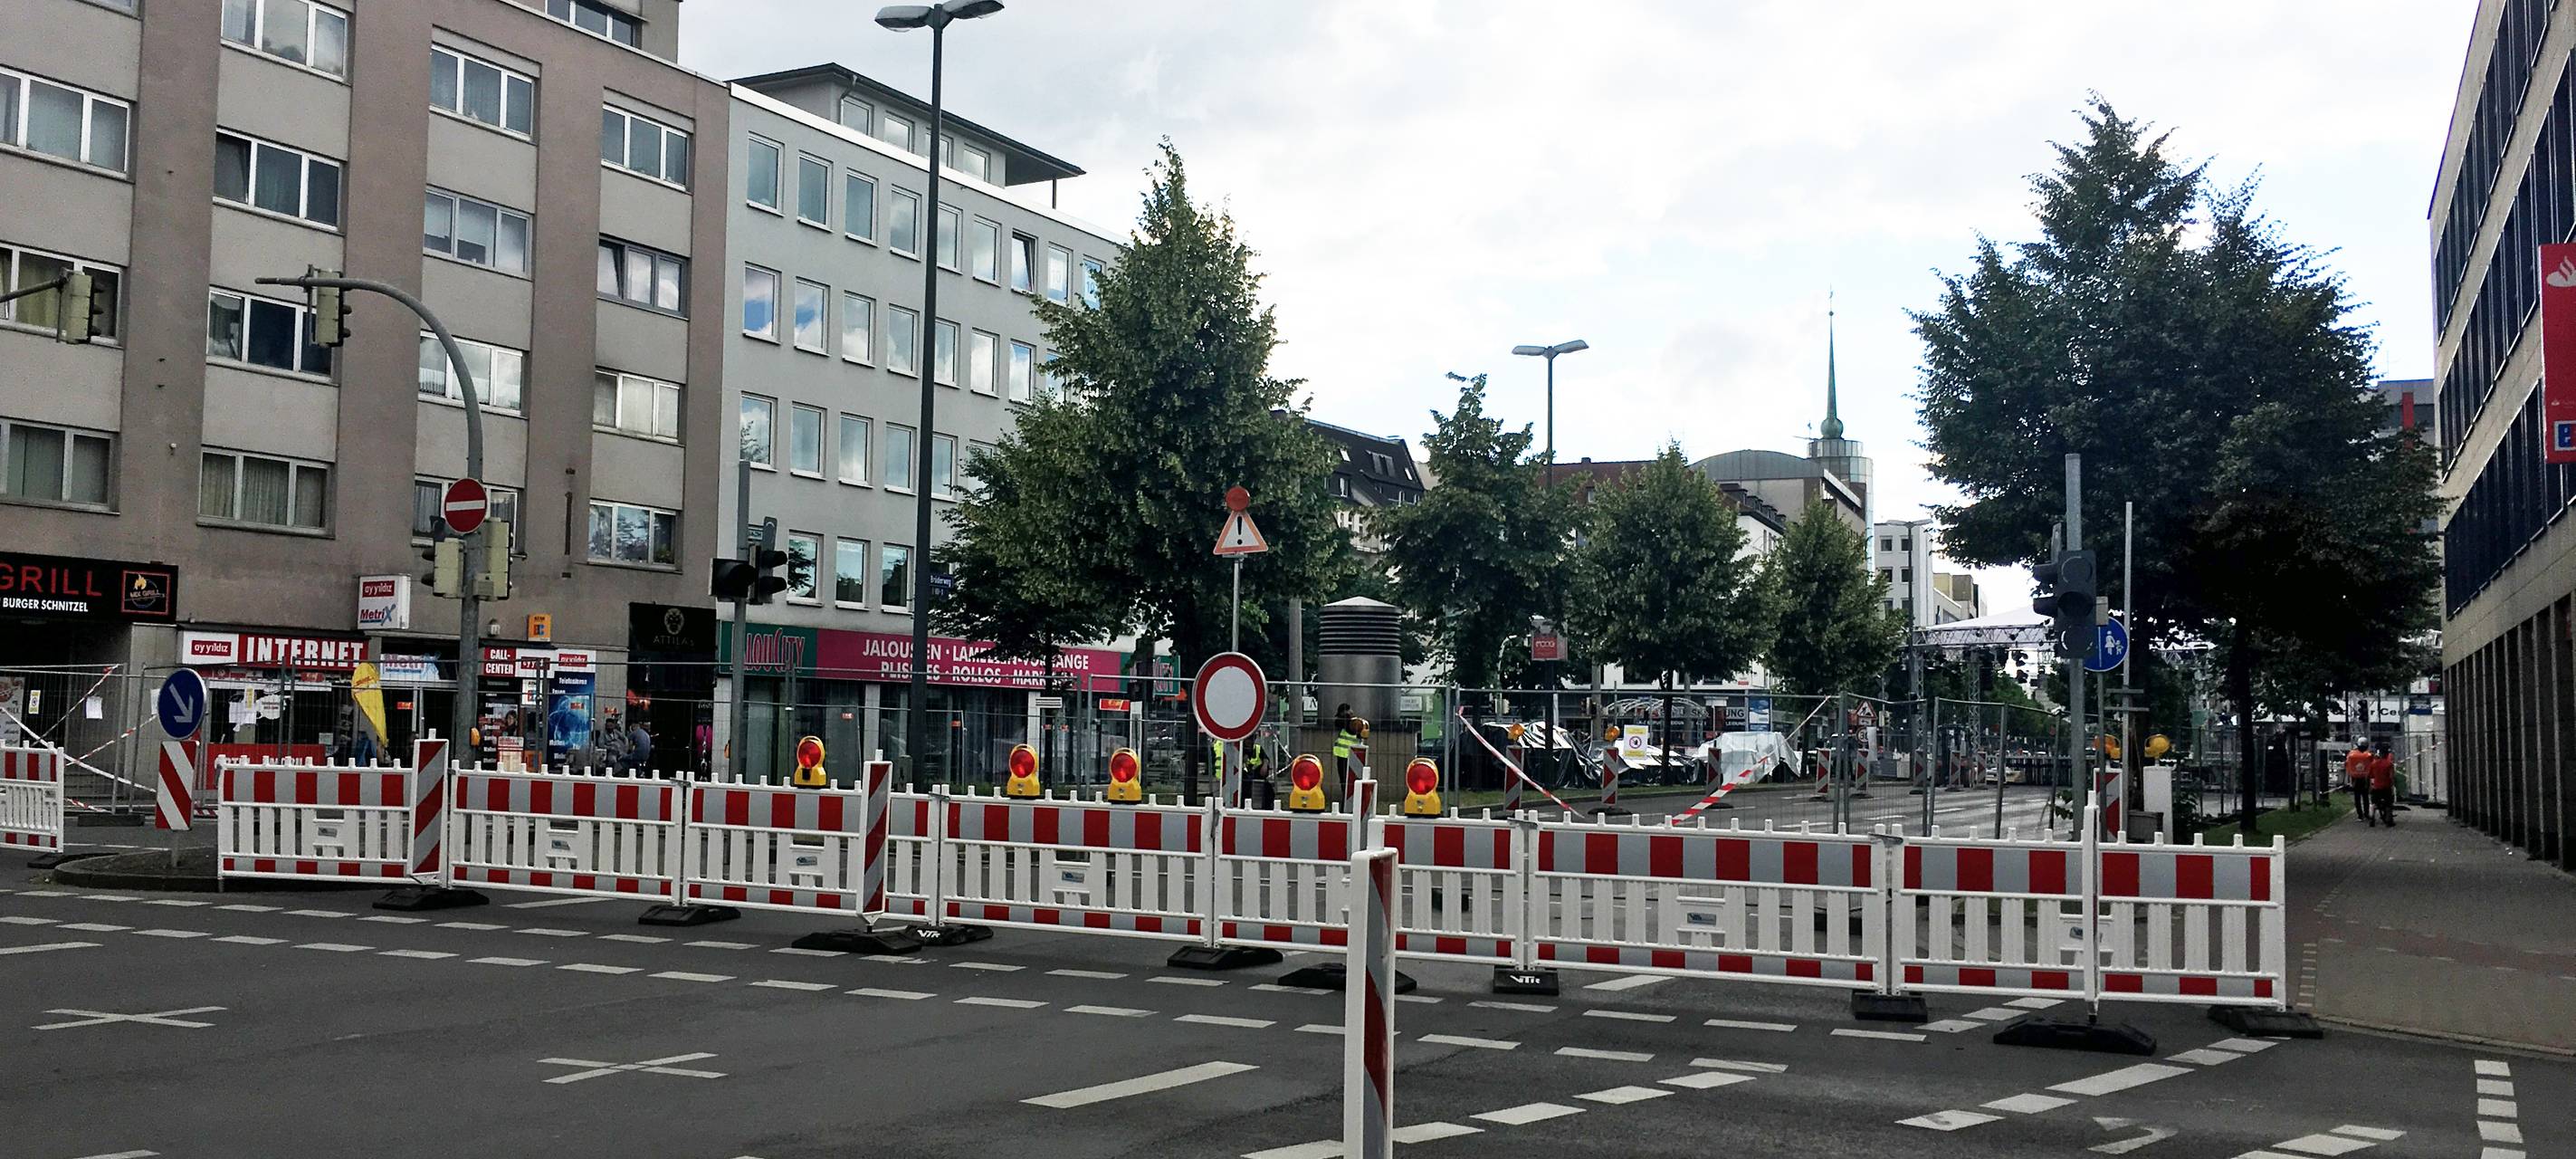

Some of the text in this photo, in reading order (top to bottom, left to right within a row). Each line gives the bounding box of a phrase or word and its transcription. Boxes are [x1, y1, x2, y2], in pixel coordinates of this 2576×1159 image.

[3, 598, 89, 612] BURGER SCHNITZEL
[194, 644, 205, 654] ay
[246, 637, 363, 668] INTERNET
[490, 649, 511, 660] CALL-
[485, 663, 514, 675] CENTER
